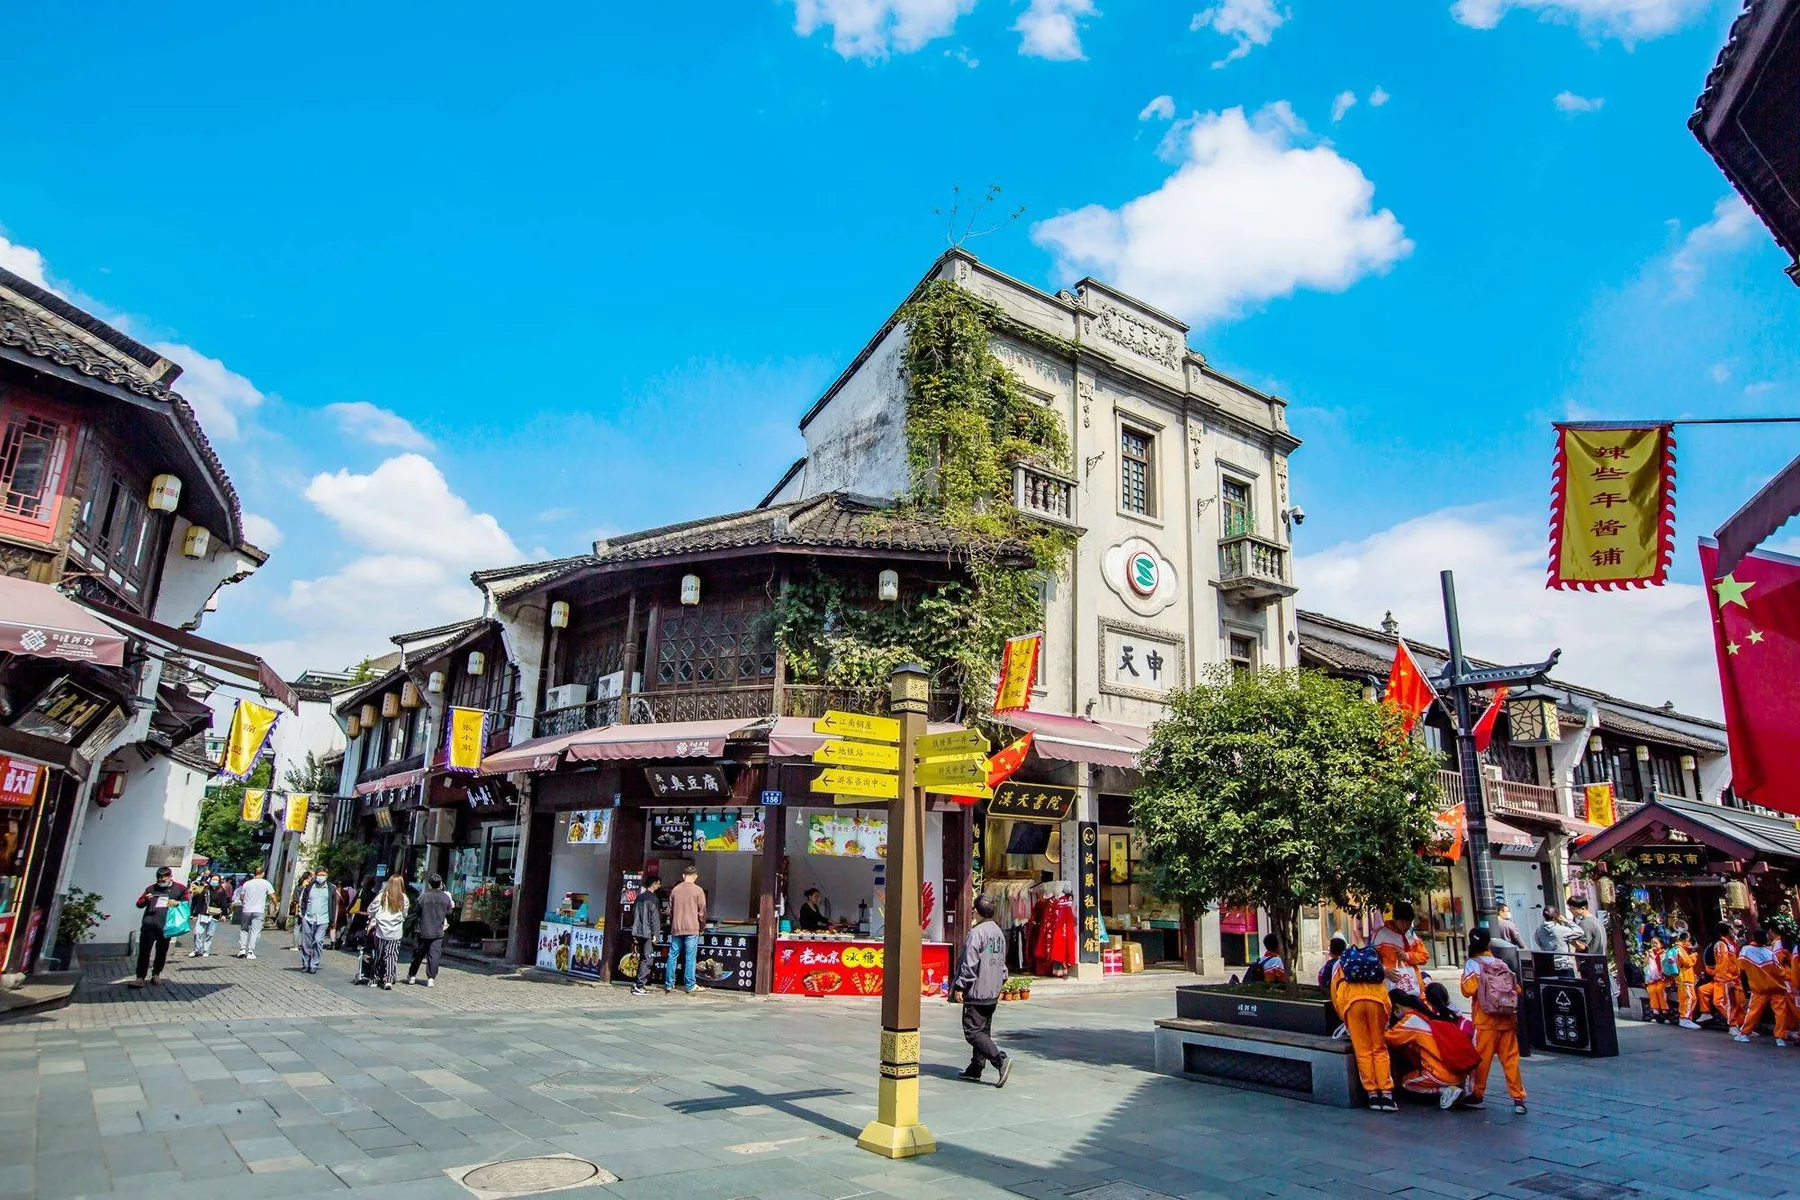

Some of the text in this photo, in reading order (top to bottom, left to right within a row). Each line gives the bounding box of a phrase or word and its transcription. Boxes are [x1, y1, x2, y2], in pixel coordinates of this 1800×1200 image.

[670, 773, 719, 792] 臭豆腐
[765, 795, 779, 803] 156
[799, 947, 840, 964] 老北京
